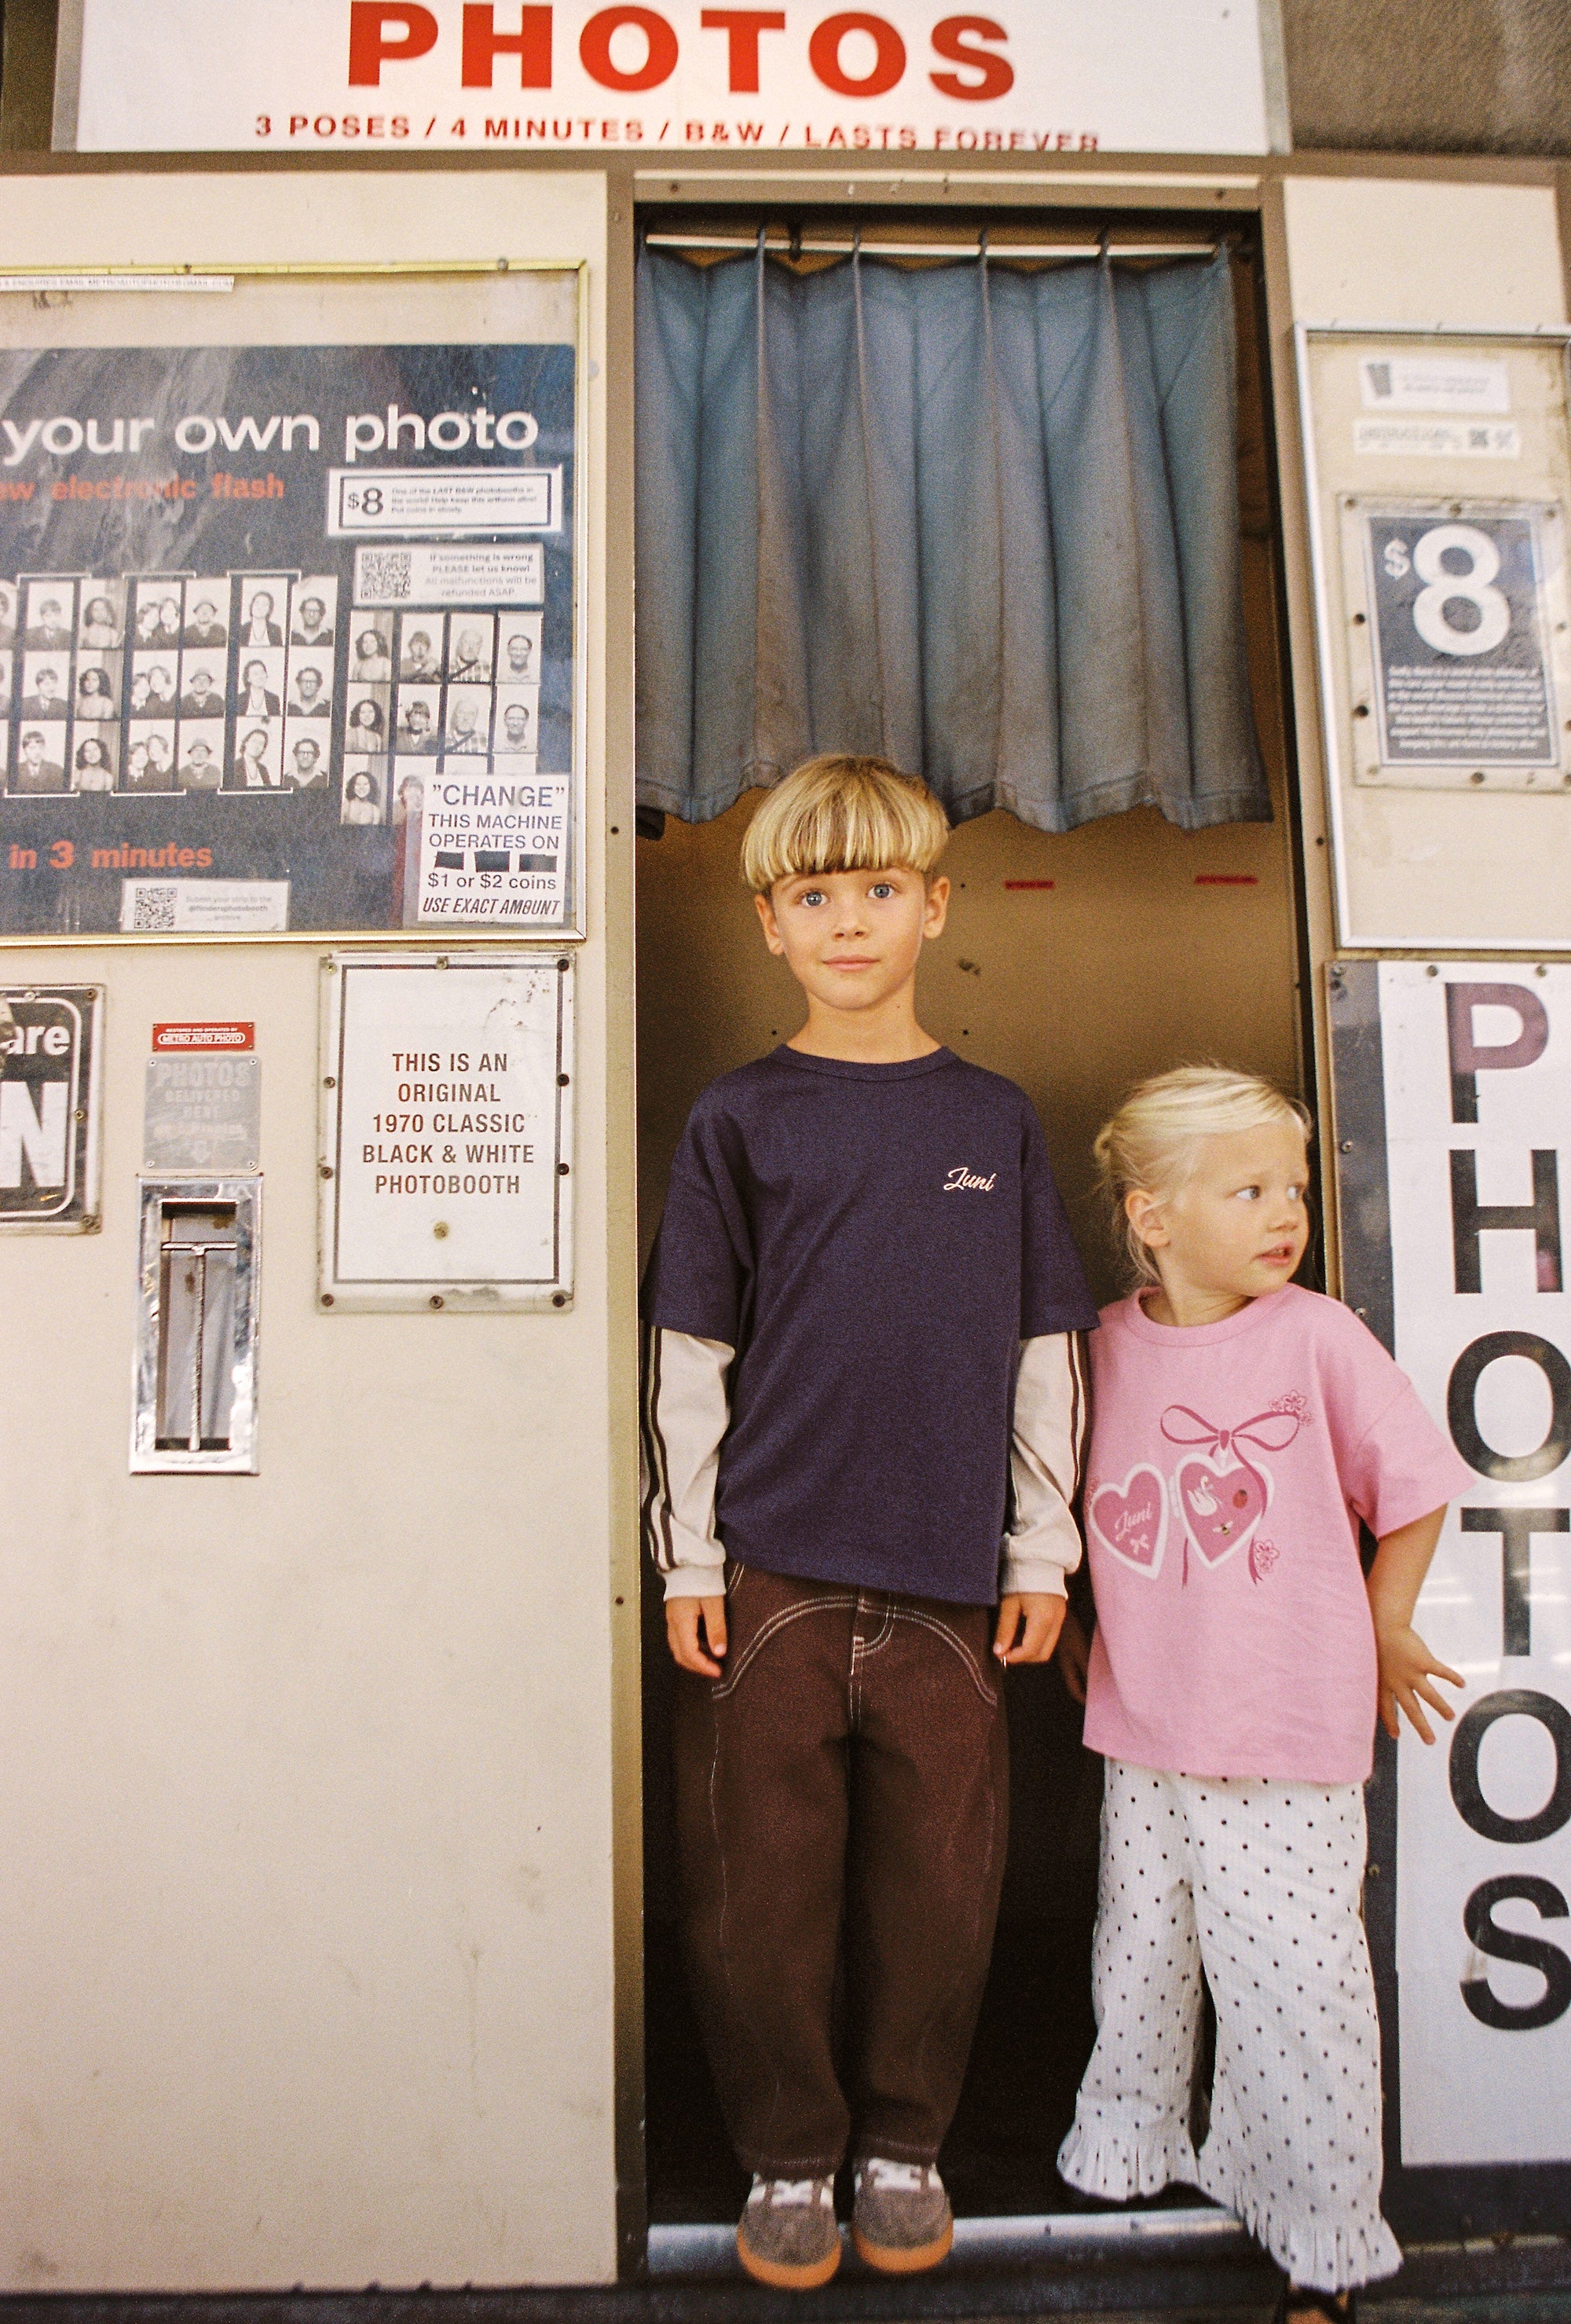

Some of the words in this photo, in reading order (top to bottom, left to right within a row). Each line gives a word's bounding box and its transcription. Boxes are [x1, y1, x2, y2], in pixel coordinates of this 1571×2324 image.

[348, 0, 1014, 101] PHOTOS
[255, 115, 272, 137] 3
[290, 115, 410, 138] POSES
[450, 117, 467, 137] 4
[485, 119, 643, 141] MINUTES
[685, 123, 766, 144] B&W
[805, 125, 917, 150] LASTS
[934, 127, 1099, 152] FOREVER
[2, 416, 155, 467] your
[174, 415, 320, 454] own
[345, 403, 539, 463] photo
[52, 474, 197, 500] electronic
[211, 472, 285, 500] flash
[347, 486, 384, 515] $8
[439, 553, 491, 563] something
[503, 553, 533, 563] wrong
[1383, 522, 1511, 657] $8
[429, 814, 471, 829] THIS
[477, 815, 562, 830] MACHINE
[429, 834, 526, 849] OPERATES
[532, 835, 560, 849] ON
[9, 844, 38, 870] in
[49, 840, 75, 869] 3
[90, 841, 214, 869] minutes
[427, 873, 449, 888] $1
[456, 876, 474, 888] or
[480, 874, 503, 889] $2
[509, 875, 556, 889] coins
[423, 898, 452, 913] USE
[452, 898, 500, 914] EXACT
[500, 900, 562, 915] AMOUNT
[162, 1035, 191, 1043] METRO
[214, 1034, 243, 1043] PHOTO
[391, 1053, 441, 1072] THIS
[449, 1053, 470, 1072] IS
[478, 1053, 507, 1072] AN
[156, 1061, 251, 1088] PHOTOS
[397, 1083, 501, 1102] ORIGINAL
[373, 1114, 424, 1133] 1970
[433, 1114, 525, 1133] CLASSIC
[362, 1145, 434, 1164] BLACK
[441, 1145, 457, 1164] &
[466, 1145, 535, 1164] WHITE
[375, 1175, 520, 1194] PHOTOBOOTH
[1445, 982, 1571, 2031] PHOTOS
